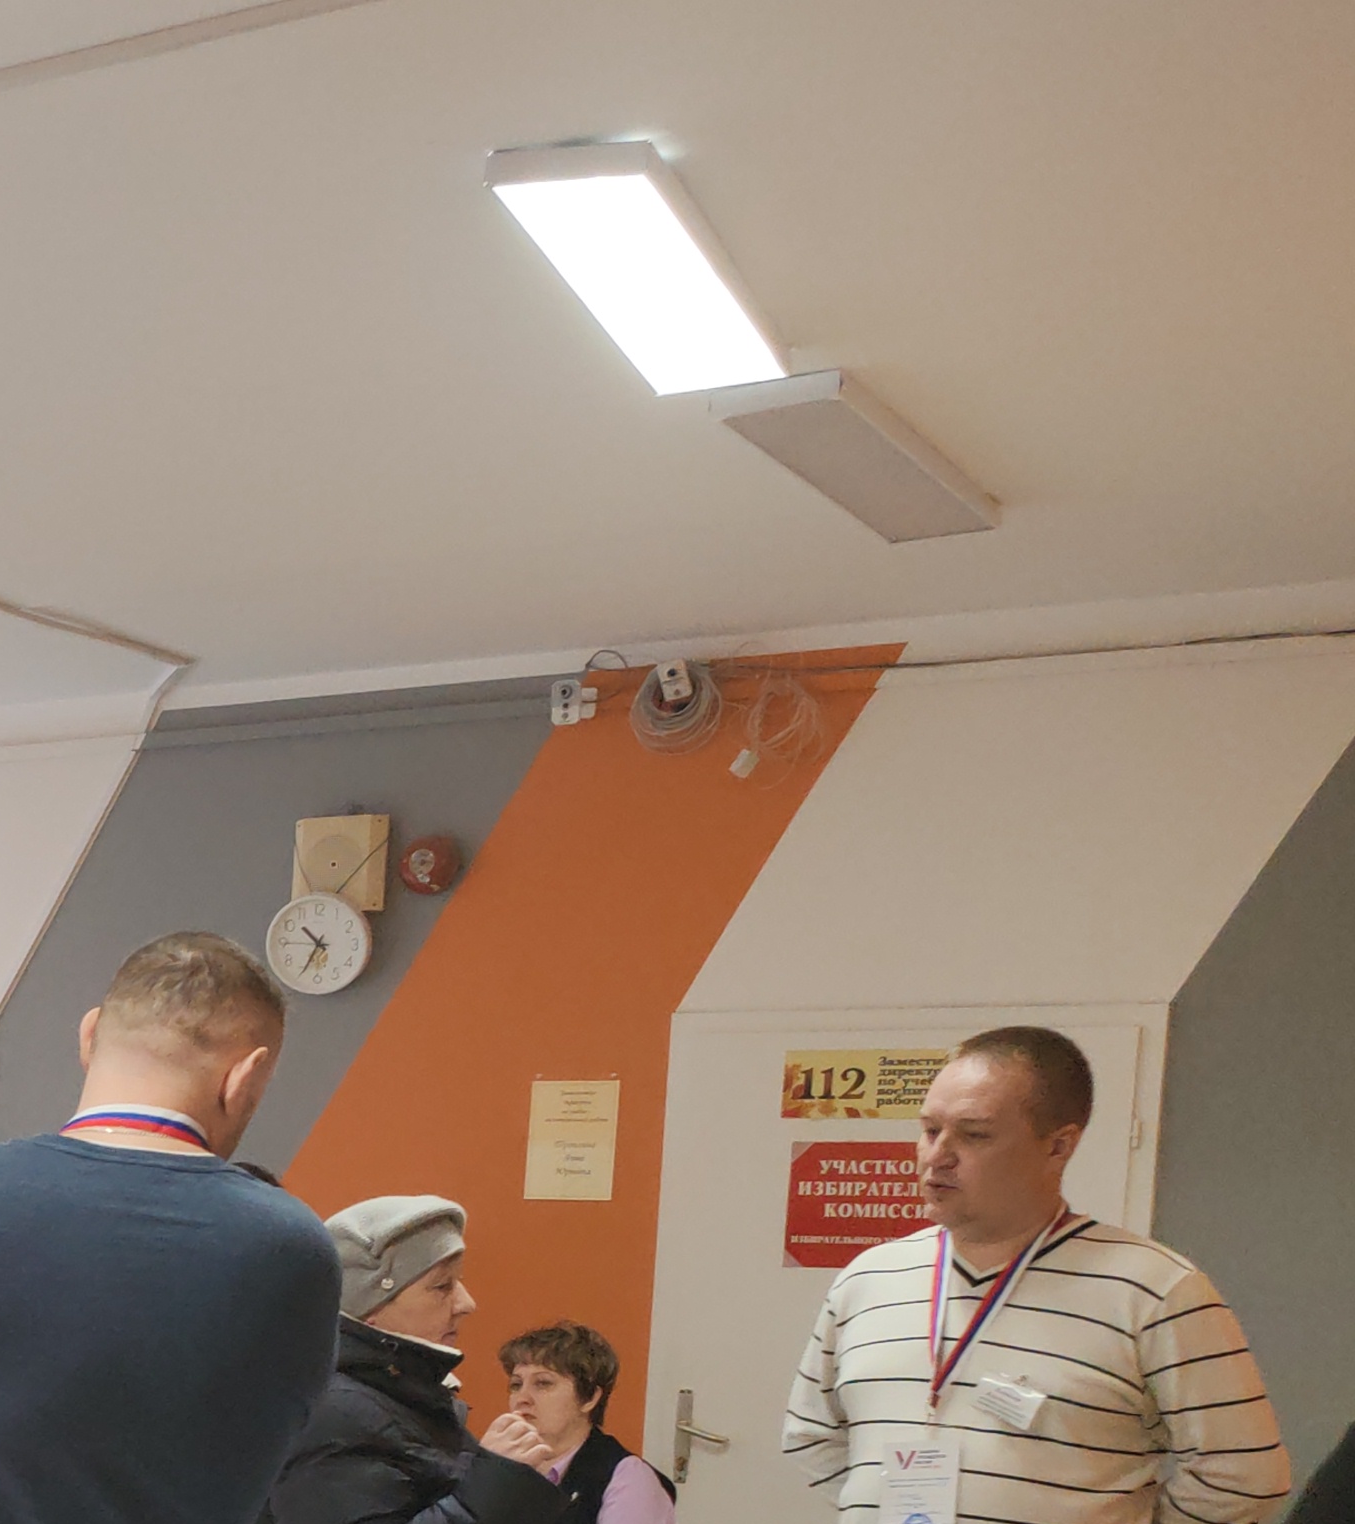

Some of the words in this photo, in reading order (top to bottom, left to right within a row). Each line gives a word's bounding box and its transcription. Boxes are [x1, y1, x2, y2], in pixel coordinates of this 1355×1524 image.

[314, 903, 325, 917] 12
[344, 919, 354, 934] 2
[350, 937, 359, 952] 3
[283, 953, 293, 967] 8
[343, 955, 353, 967] 4
[312, 973, 323, 985] 6
[331, 966, 340, 981] 5
[878, 1056, 947, 1066] Замести
[800, 1066, 867, 1100] 112
[877, 1078, 896, 1086] по
[819, 1159, 919, 1175] УЧАСТКО
[797, 1181, 922, 1197] ИЗБИРАТЕЛ
[823, 1203, 929, 1219] КОМИССИ
